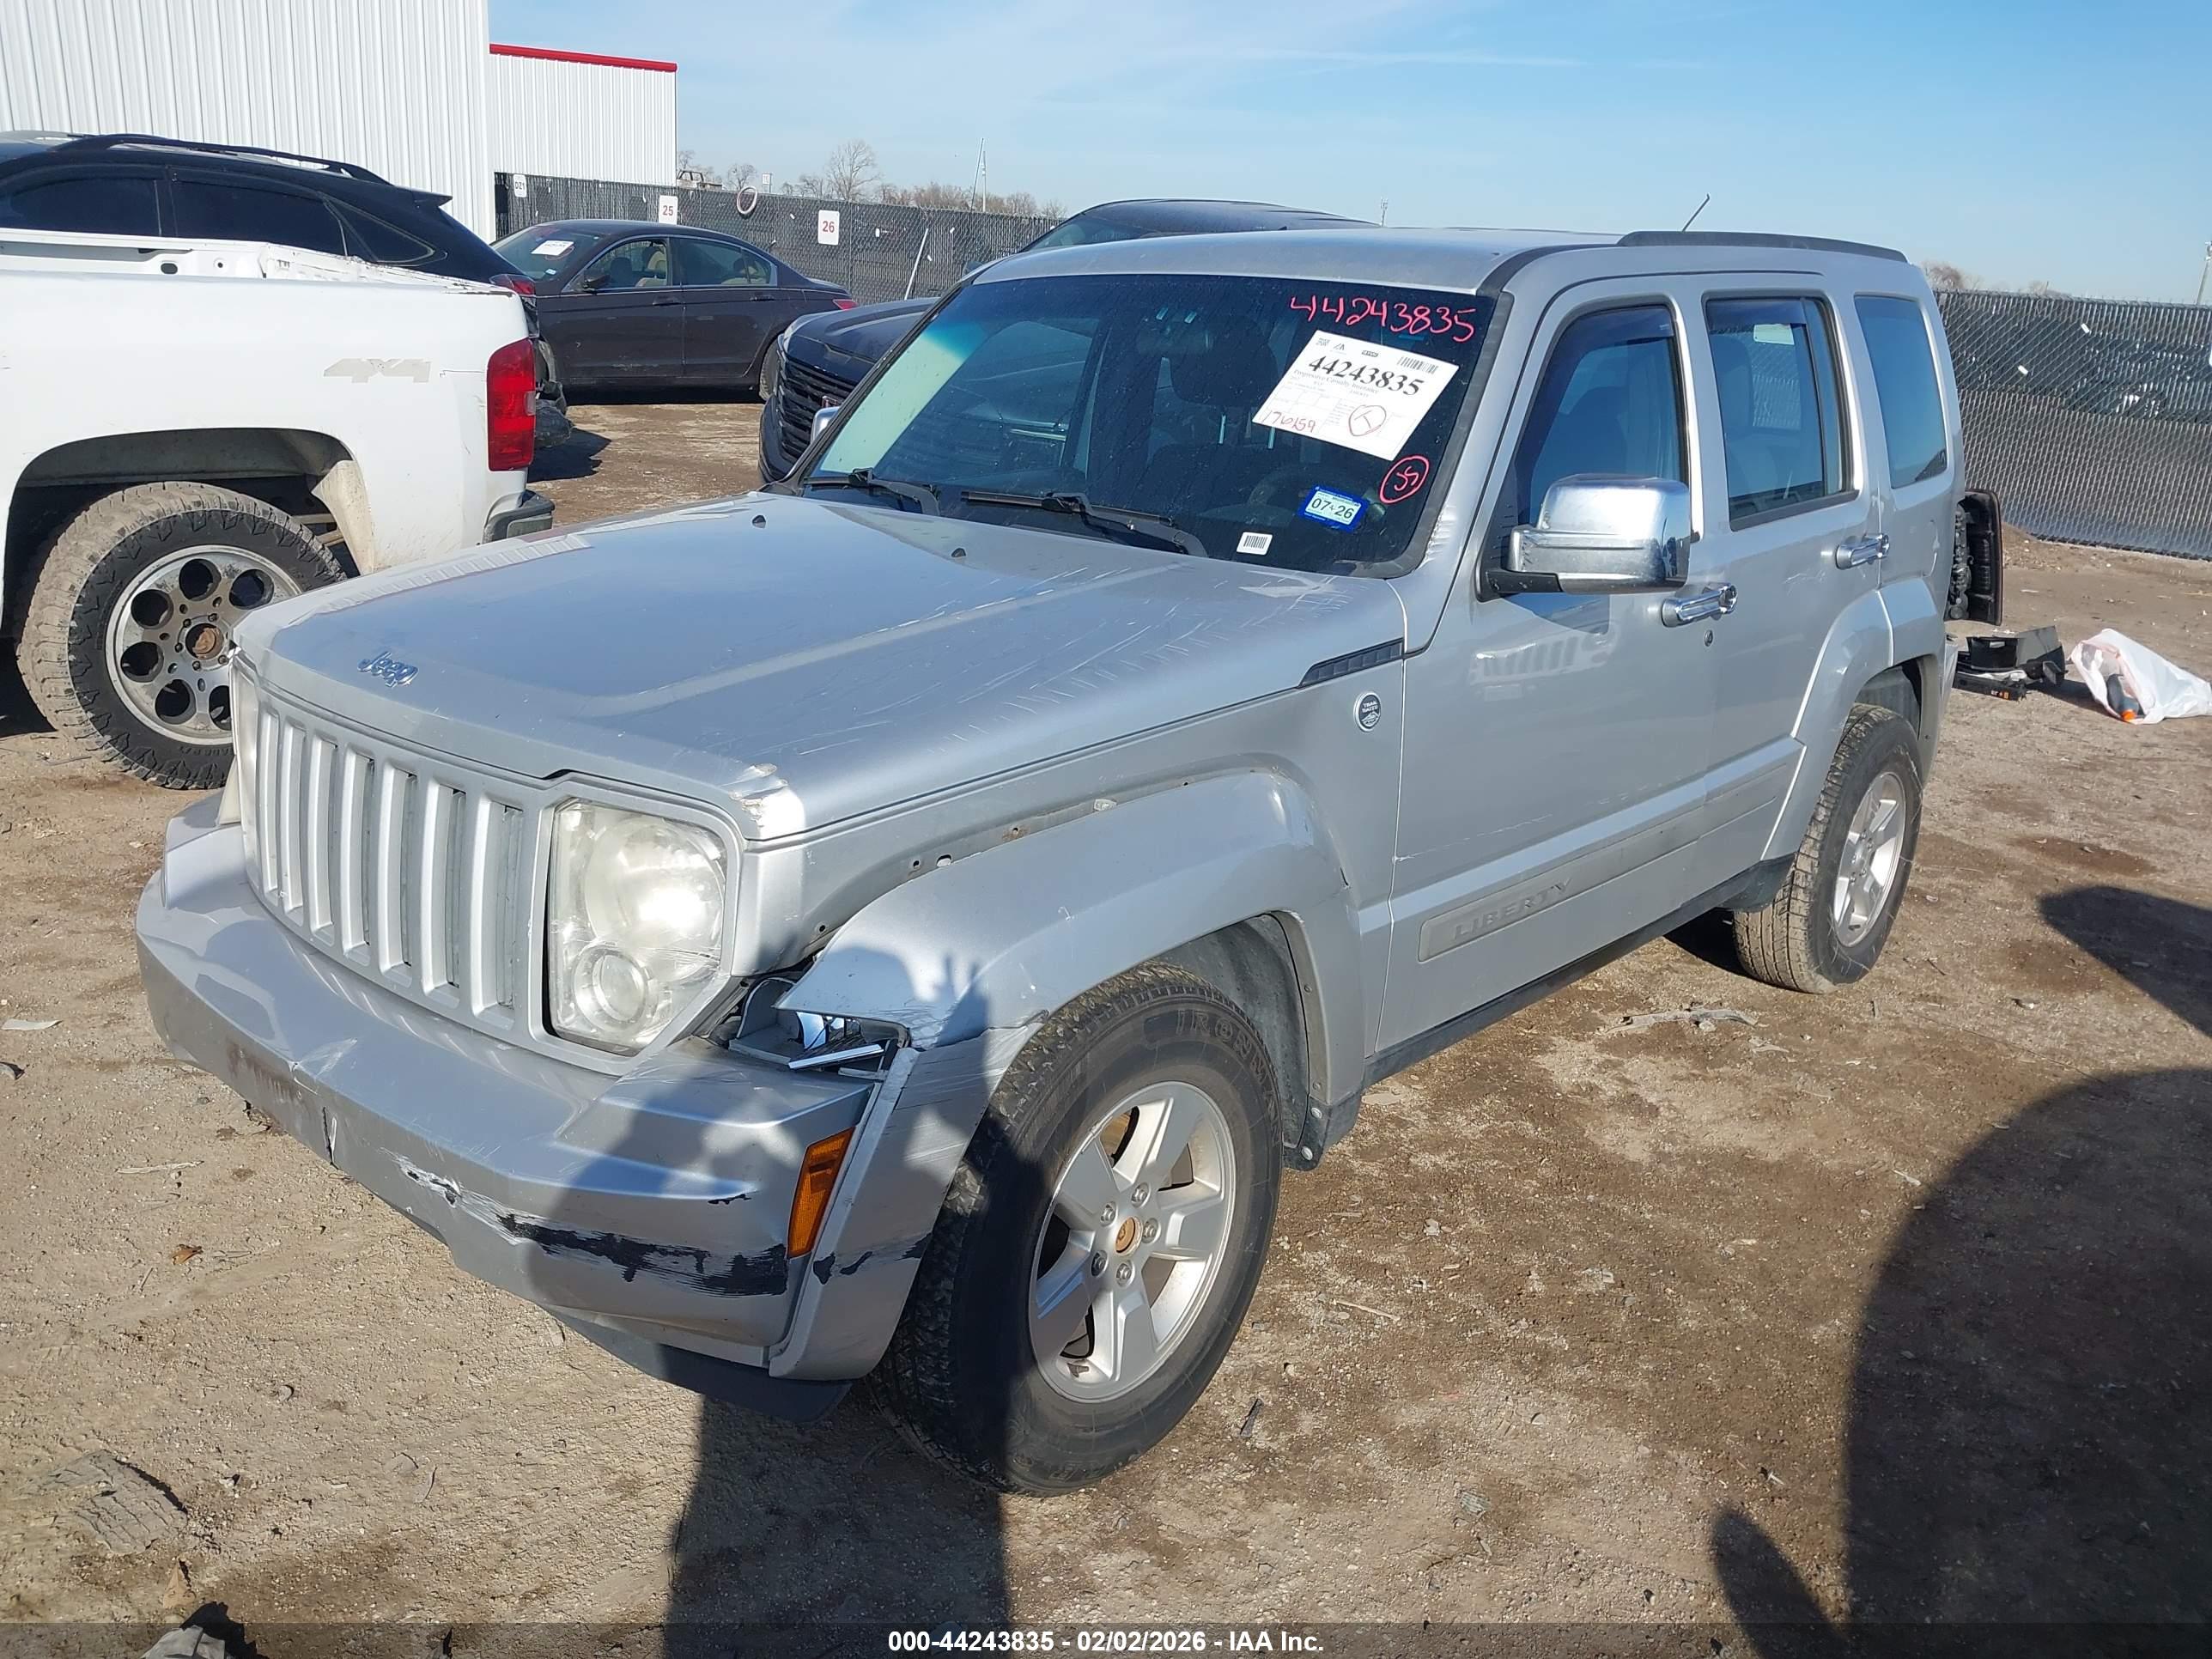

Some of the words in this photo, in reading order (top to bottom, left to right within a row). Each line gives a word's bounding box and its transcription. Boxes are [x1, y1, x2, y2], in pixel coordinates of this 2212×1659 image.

[662, 205, 673, 216] 25
[823, 221, 835, 233] 26
[1291, 295, 1476, 343] 44243835
[1309, 356, 1425, 396] 44243835
[1453, 878, 1572, 940] LIBERTY
[1176, 1008, 1282, 1147] IRONMAN
